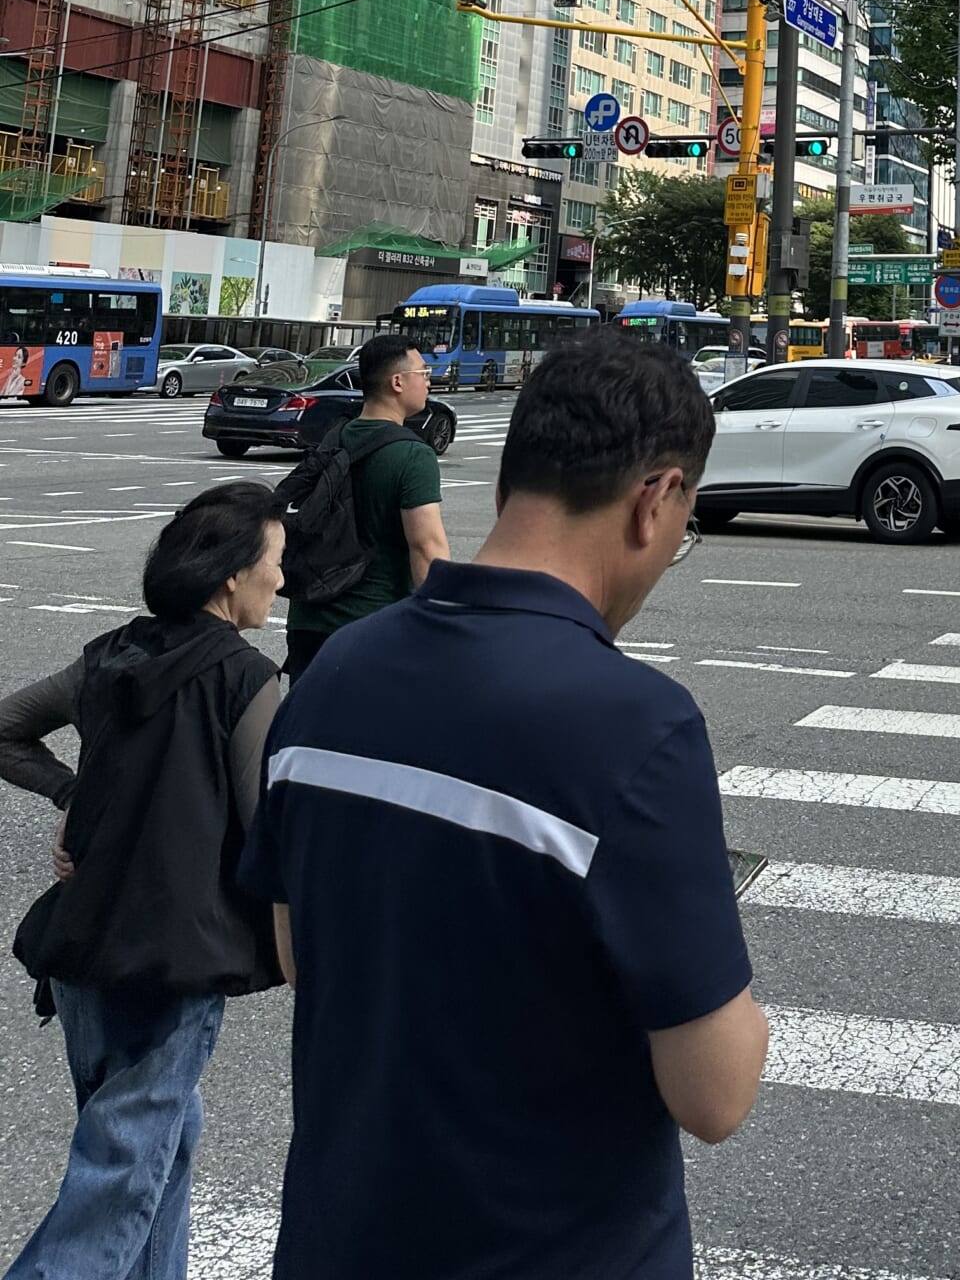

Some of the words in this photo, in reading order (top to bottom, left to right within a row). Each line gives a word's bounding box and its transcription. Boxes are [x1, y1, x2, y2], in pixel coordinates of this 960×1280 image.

[585, 134, 600, 146] U턴
[859, 193, 903, 203] 우편취급국
[55, 331, 78, 345] 420
